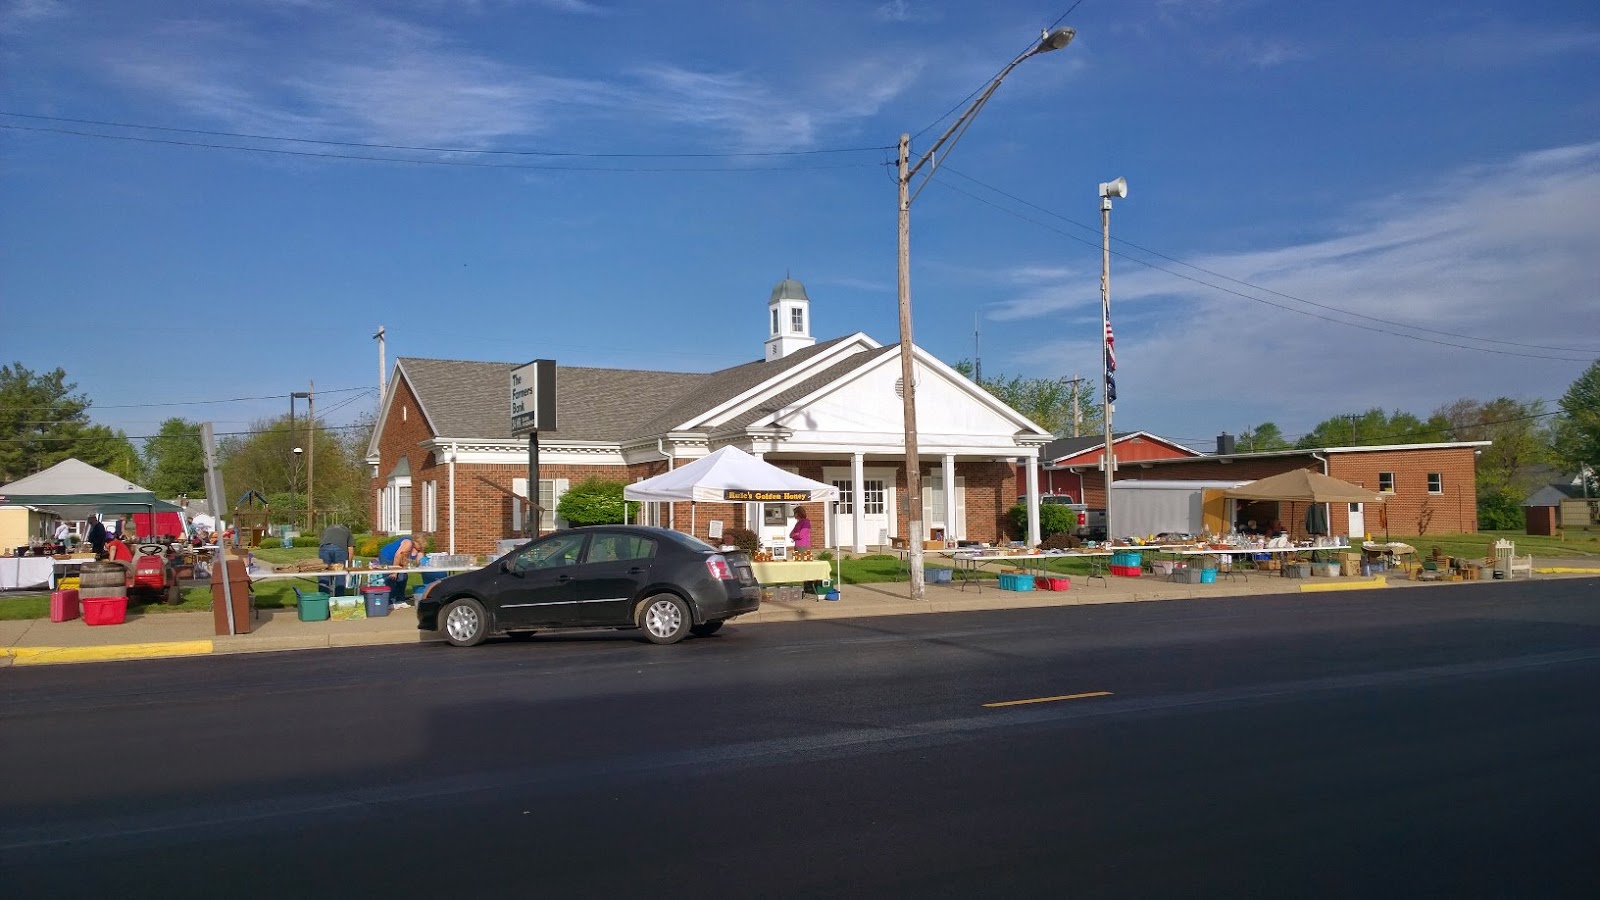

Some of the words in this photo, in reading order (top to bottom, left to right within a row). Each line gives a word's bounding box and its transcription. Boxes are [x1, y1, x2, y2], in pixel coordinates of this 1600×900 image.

[512, 374, 522, 387] The
[512, 387, 533, 401] Farmers
[512, 401, 525, 415] Bank
[755, 492, 782, 500] Golden
[783, 492, 807, 501] Honey
